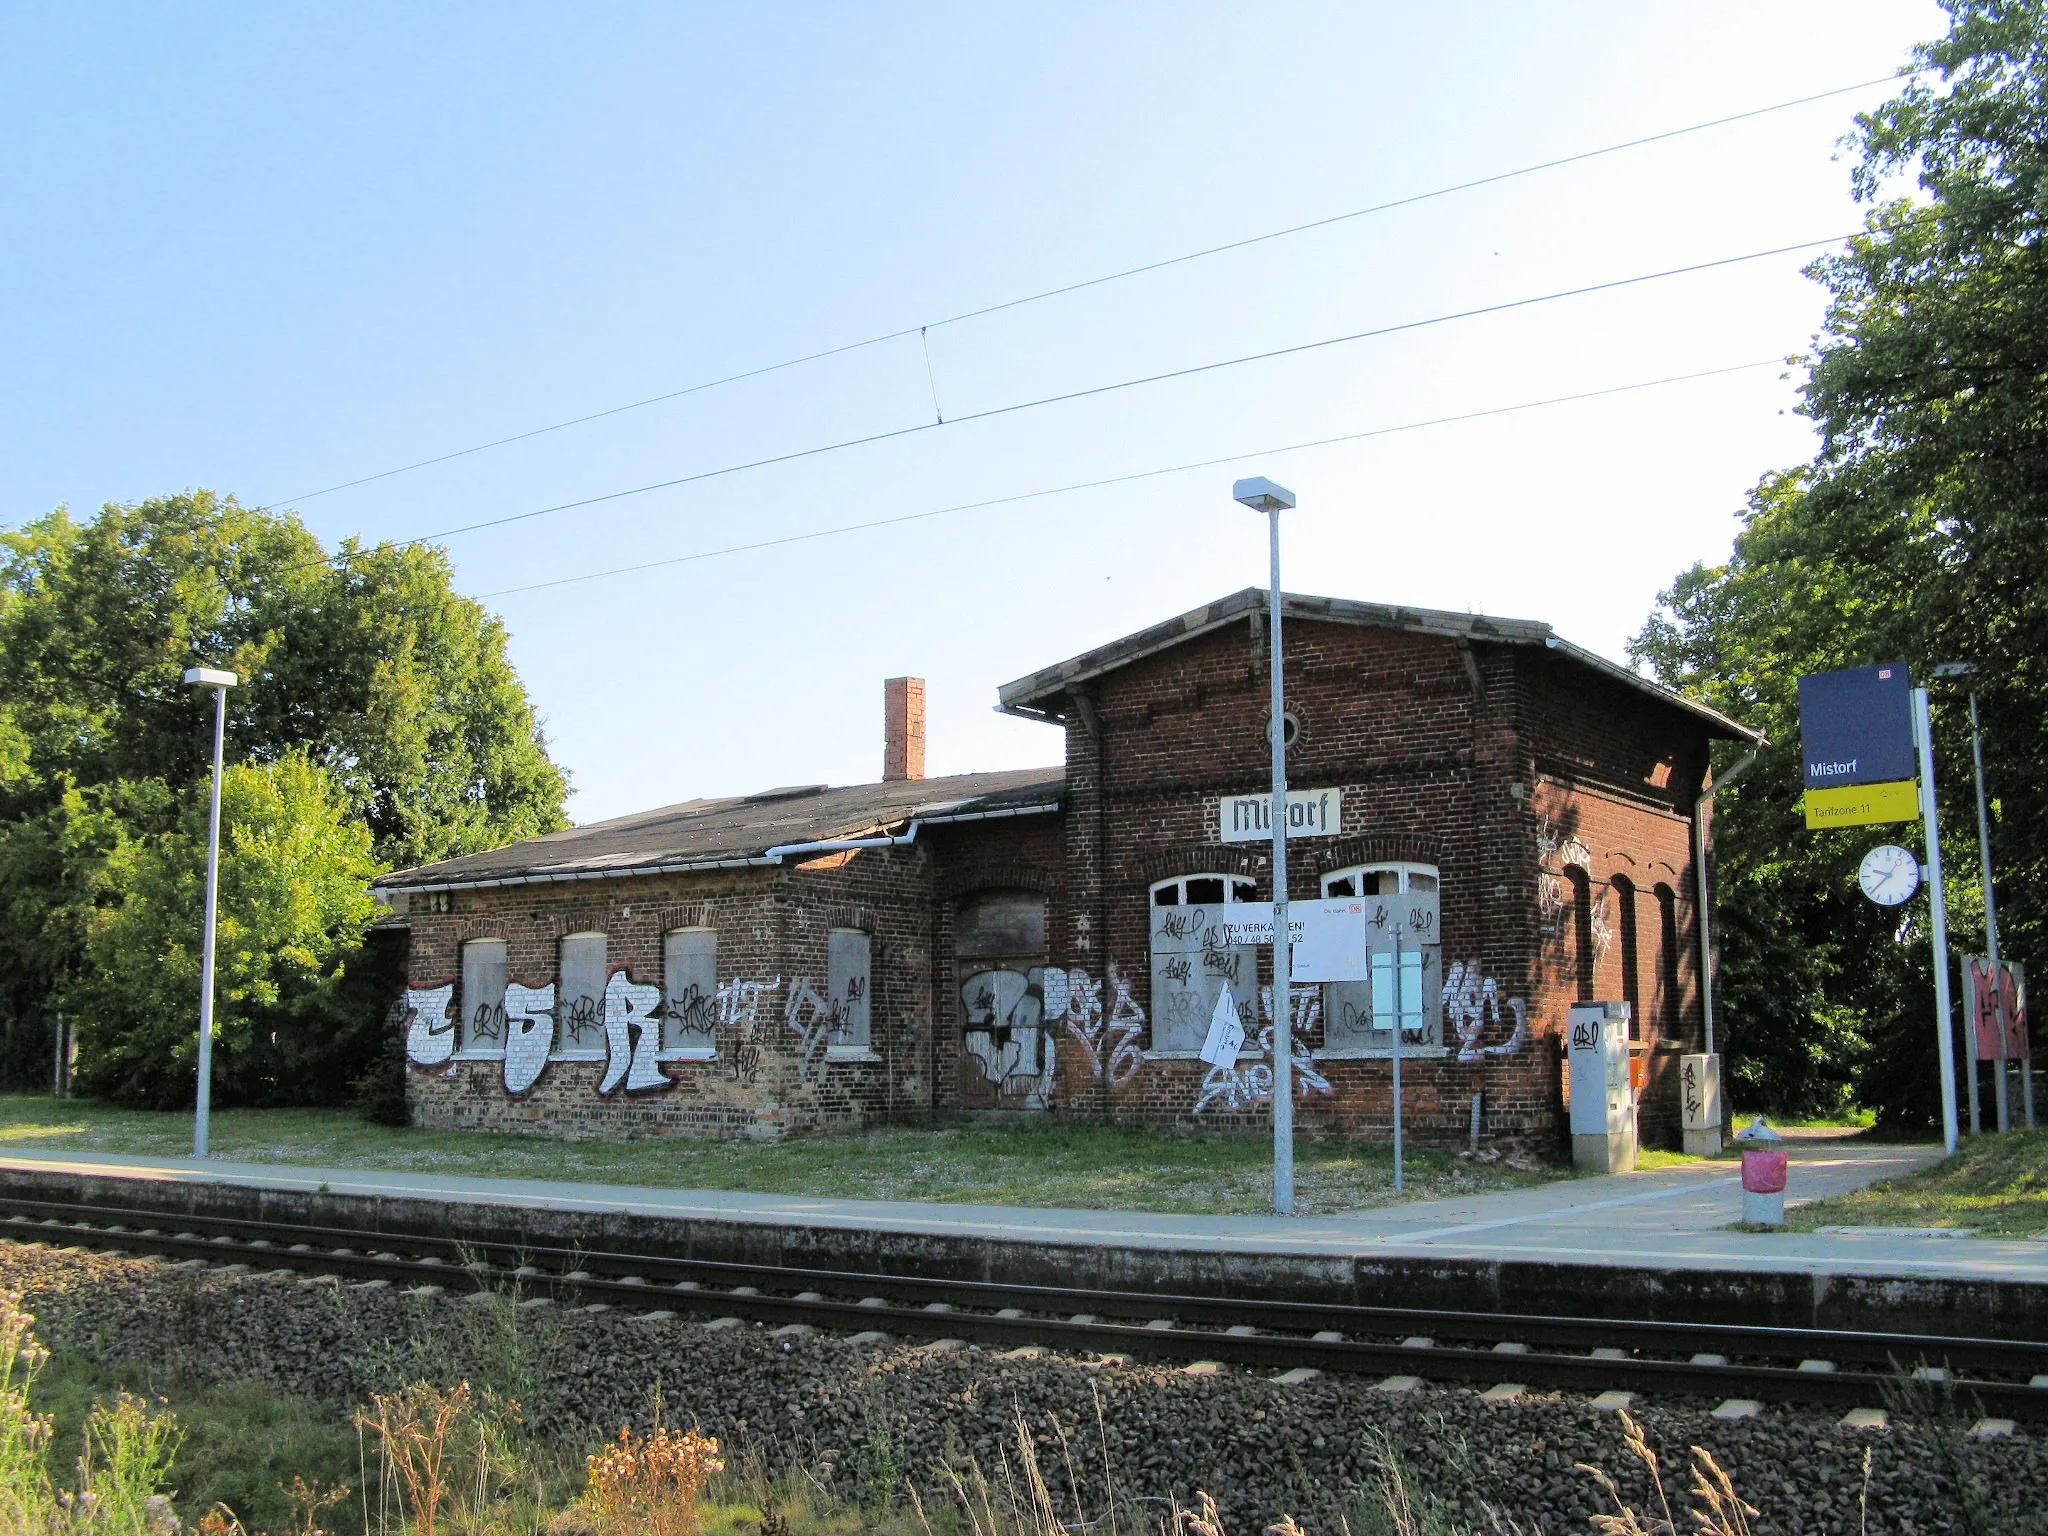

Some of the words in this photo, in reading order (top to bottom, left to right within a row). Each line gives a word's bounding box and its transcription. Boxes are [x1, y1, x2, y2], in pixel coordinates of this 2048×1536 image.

[1810, 760, 1857, 777] Mistorf
[1233, 793, 1328, 832] Miorf
[1814, 806, 1857, 817] Tarifzone
[1861, 804, 1870, 813] 11
[1229, 924, 1240, 933] ZU
[1243, 922, 1305, 933] VERKAEN!
[1292, 933, 1303, 943] 52
